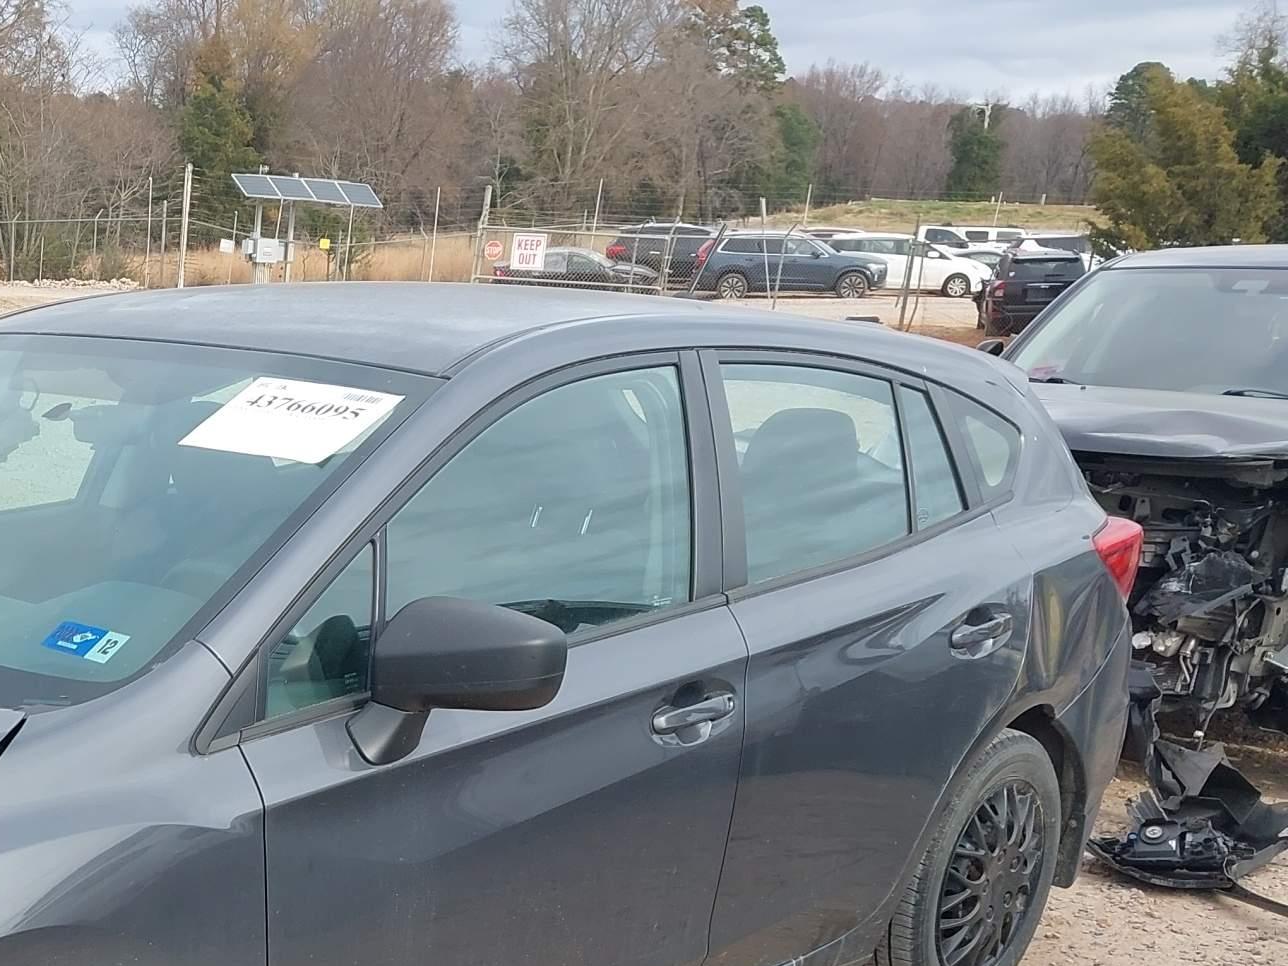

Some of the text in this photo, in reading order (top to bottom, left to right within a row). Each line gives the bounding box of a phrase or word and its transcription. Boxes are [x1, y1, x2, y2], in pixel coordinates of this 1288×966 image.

[517, 239, 542, 251] KEEP
[518, 253, 537, 265] OUT
[246, 393, 368, 420] 43766095
[96, 638, 119, 655] 12
